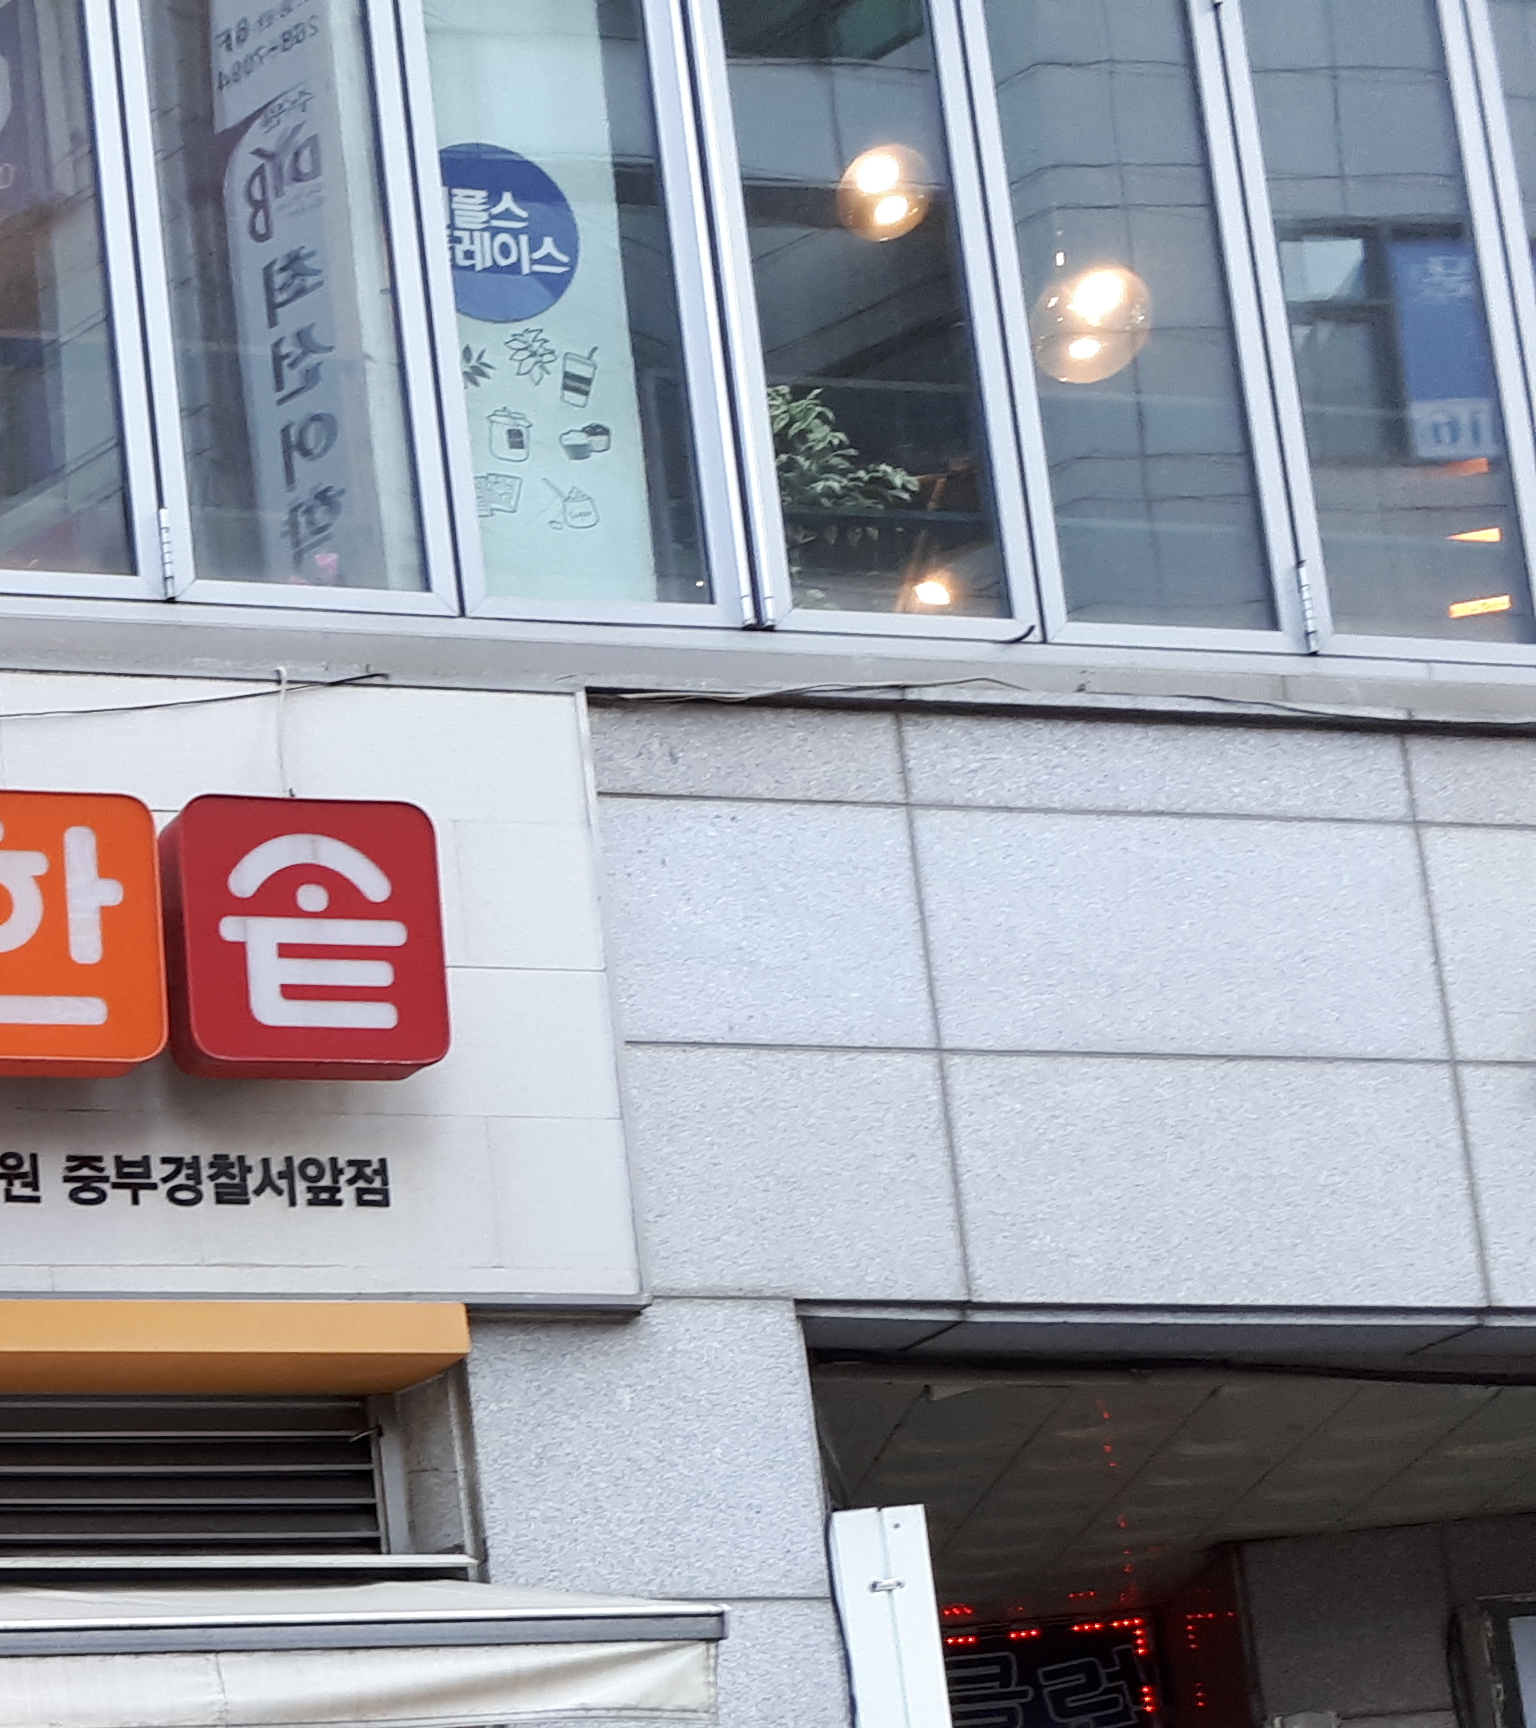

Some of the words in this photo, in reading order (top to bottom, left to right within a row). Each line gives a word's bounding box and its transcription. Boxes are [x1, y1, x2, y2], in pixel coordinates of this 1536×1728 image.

[442, 186, 529, 230] 플스
[447, 229, 571, 276] 레이스
[62, 1153, 393, 1209] 중부경찰서앞점
